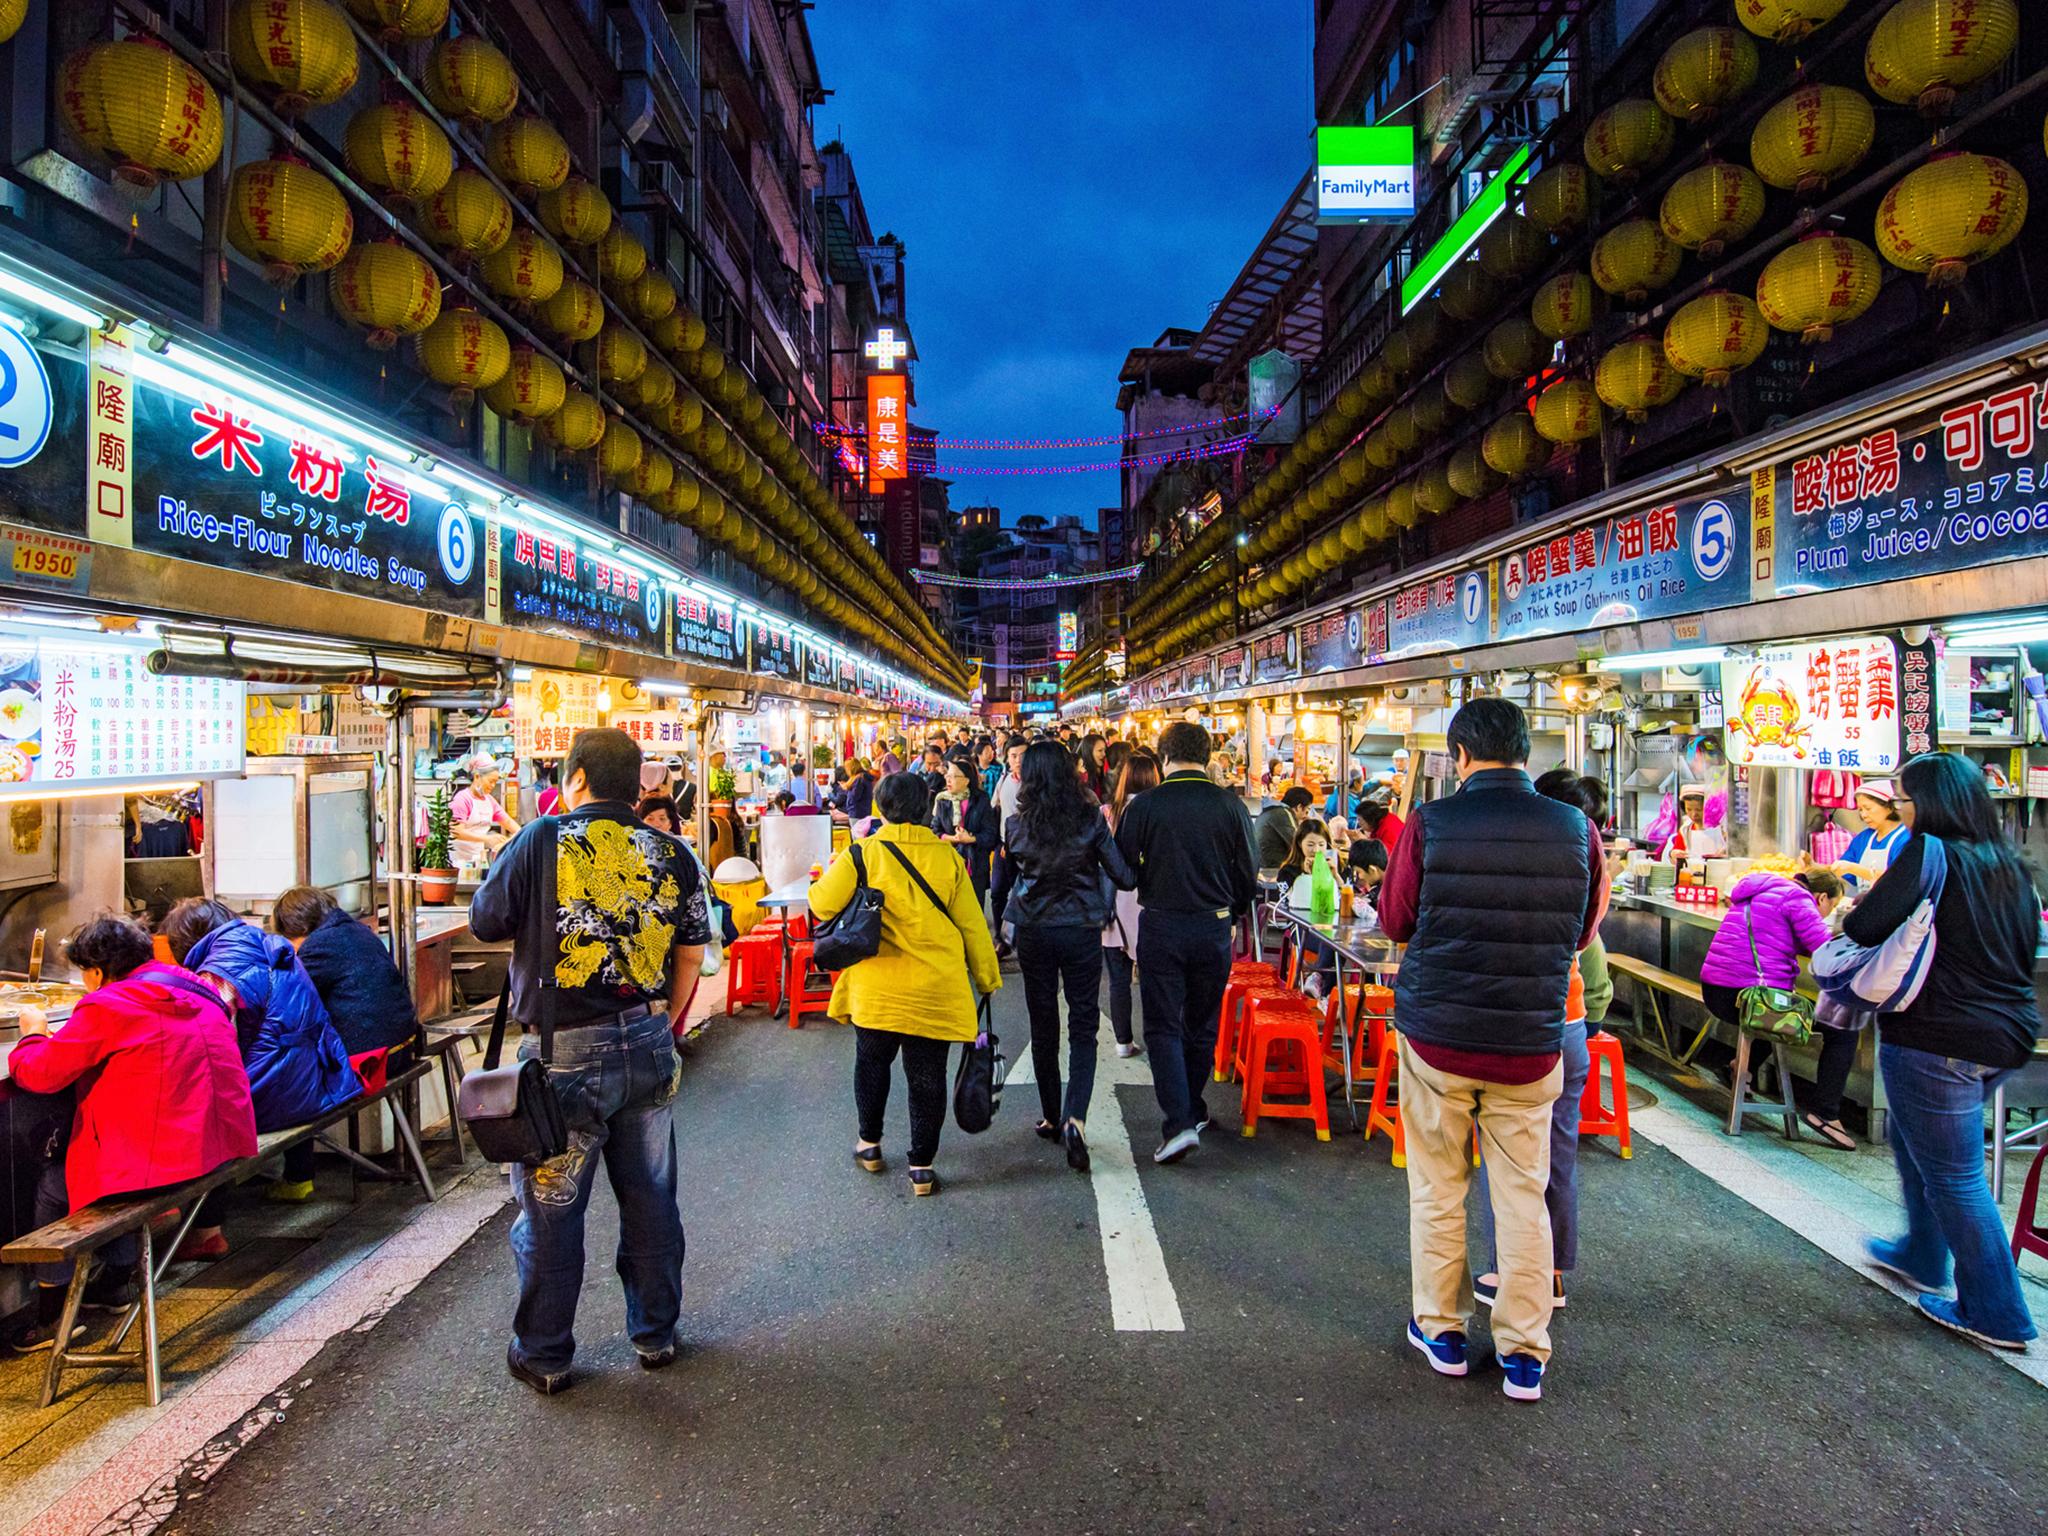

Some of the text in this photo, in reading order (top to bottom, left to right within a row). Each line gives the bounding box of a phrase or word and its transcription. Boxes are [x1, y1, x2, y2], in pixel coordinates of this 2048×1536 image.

[1322, 179, 1410, 198] FamilyMart
[876, 395, 899, 471] 康是美
[191, 397, 411, 526] 米粉湯
[260, 490, 368, 545] ビーフンスープ
[158, 494, 427, 597] Rice-Flour Noodles Soup
[449, 517, 467, 569] 6
[1700, 512, 1726, 568] 5
[22, 548, 73, 576] 1950
[1796, 544, 1849, 573] Plum
[649, 590, 658, 622] 8
[1467, 584, 1477, 617] 7
[1527, 604, 1549, 622] Thick
[1638, 583, 1653, 601] Oil
[1660, 577, 1686, 598] Rice
[53, 669, 78, 758] 米粉湯
[90, 697, 103, 708] 100
[659, 721, 684, 742] 油飯
[1844, 727, 1861, 739] 55
[54, 760, 75, 778] 25
[1812, 747, 1890, 768] 油飯 30
